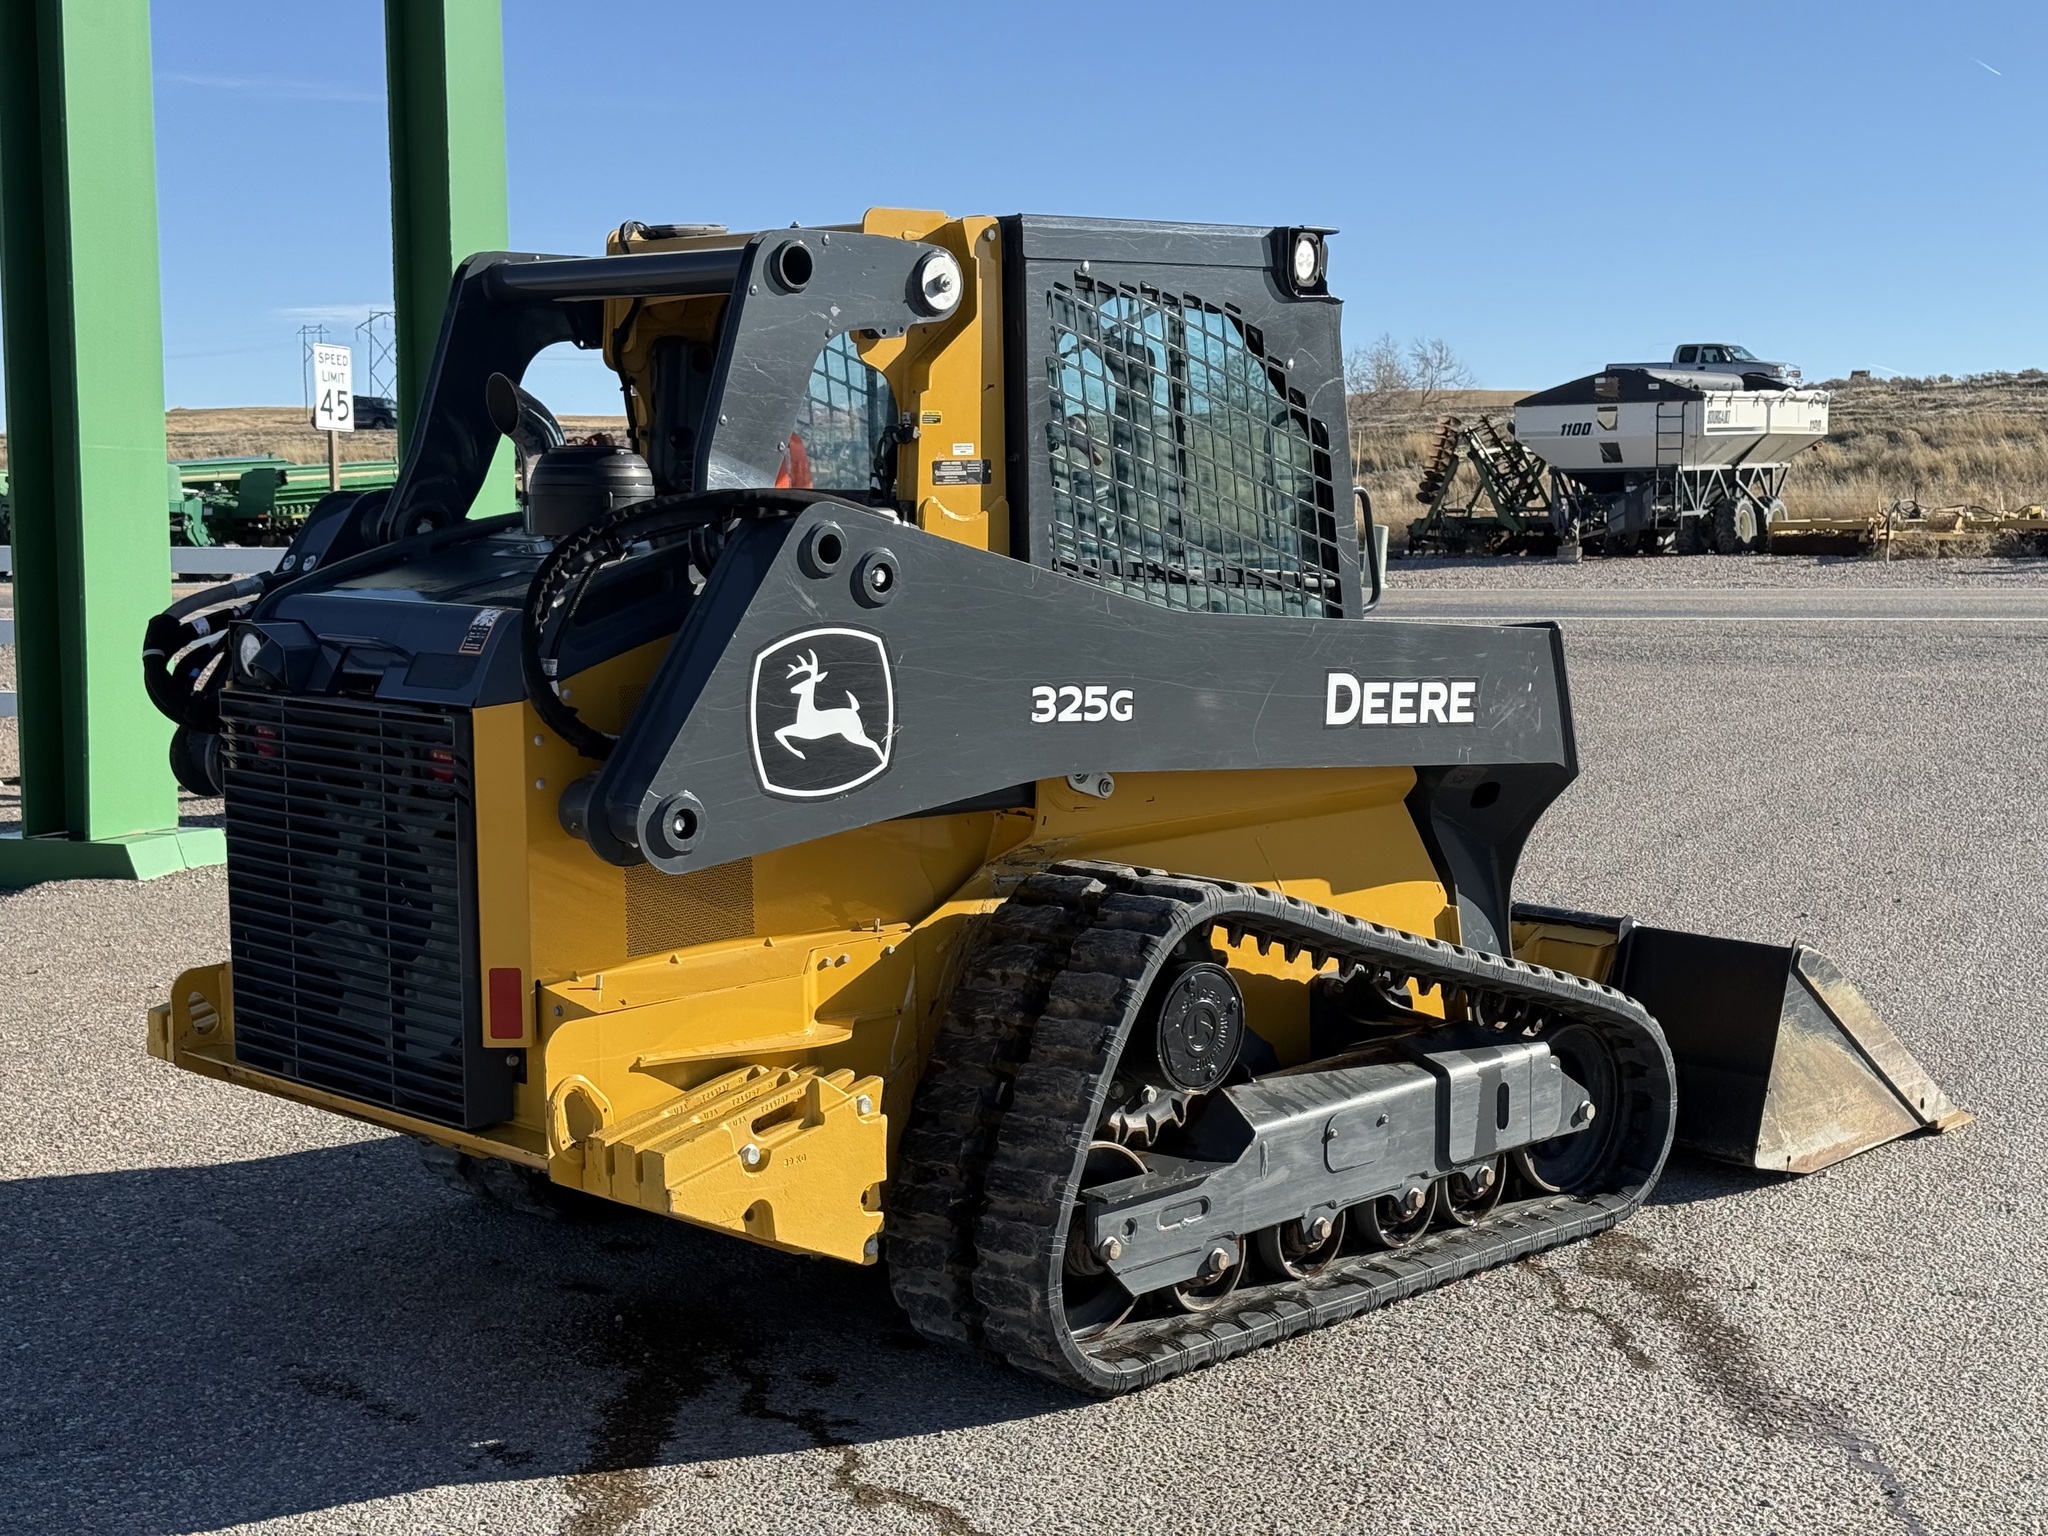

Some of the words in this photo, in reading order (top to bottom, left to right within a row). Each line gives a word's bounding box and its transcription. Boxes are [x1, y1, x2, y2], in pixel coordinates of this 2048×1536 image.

[318, 352, 348, 366] SPEED
[321, 370, 346, 384] LIMIT
[320, 388, 349, 422] 45
[1560, 422, 1592, 436] 1100
[1030, 686, 1135, 724] 325G
[1325, 672, 1476, 725] DEERE
